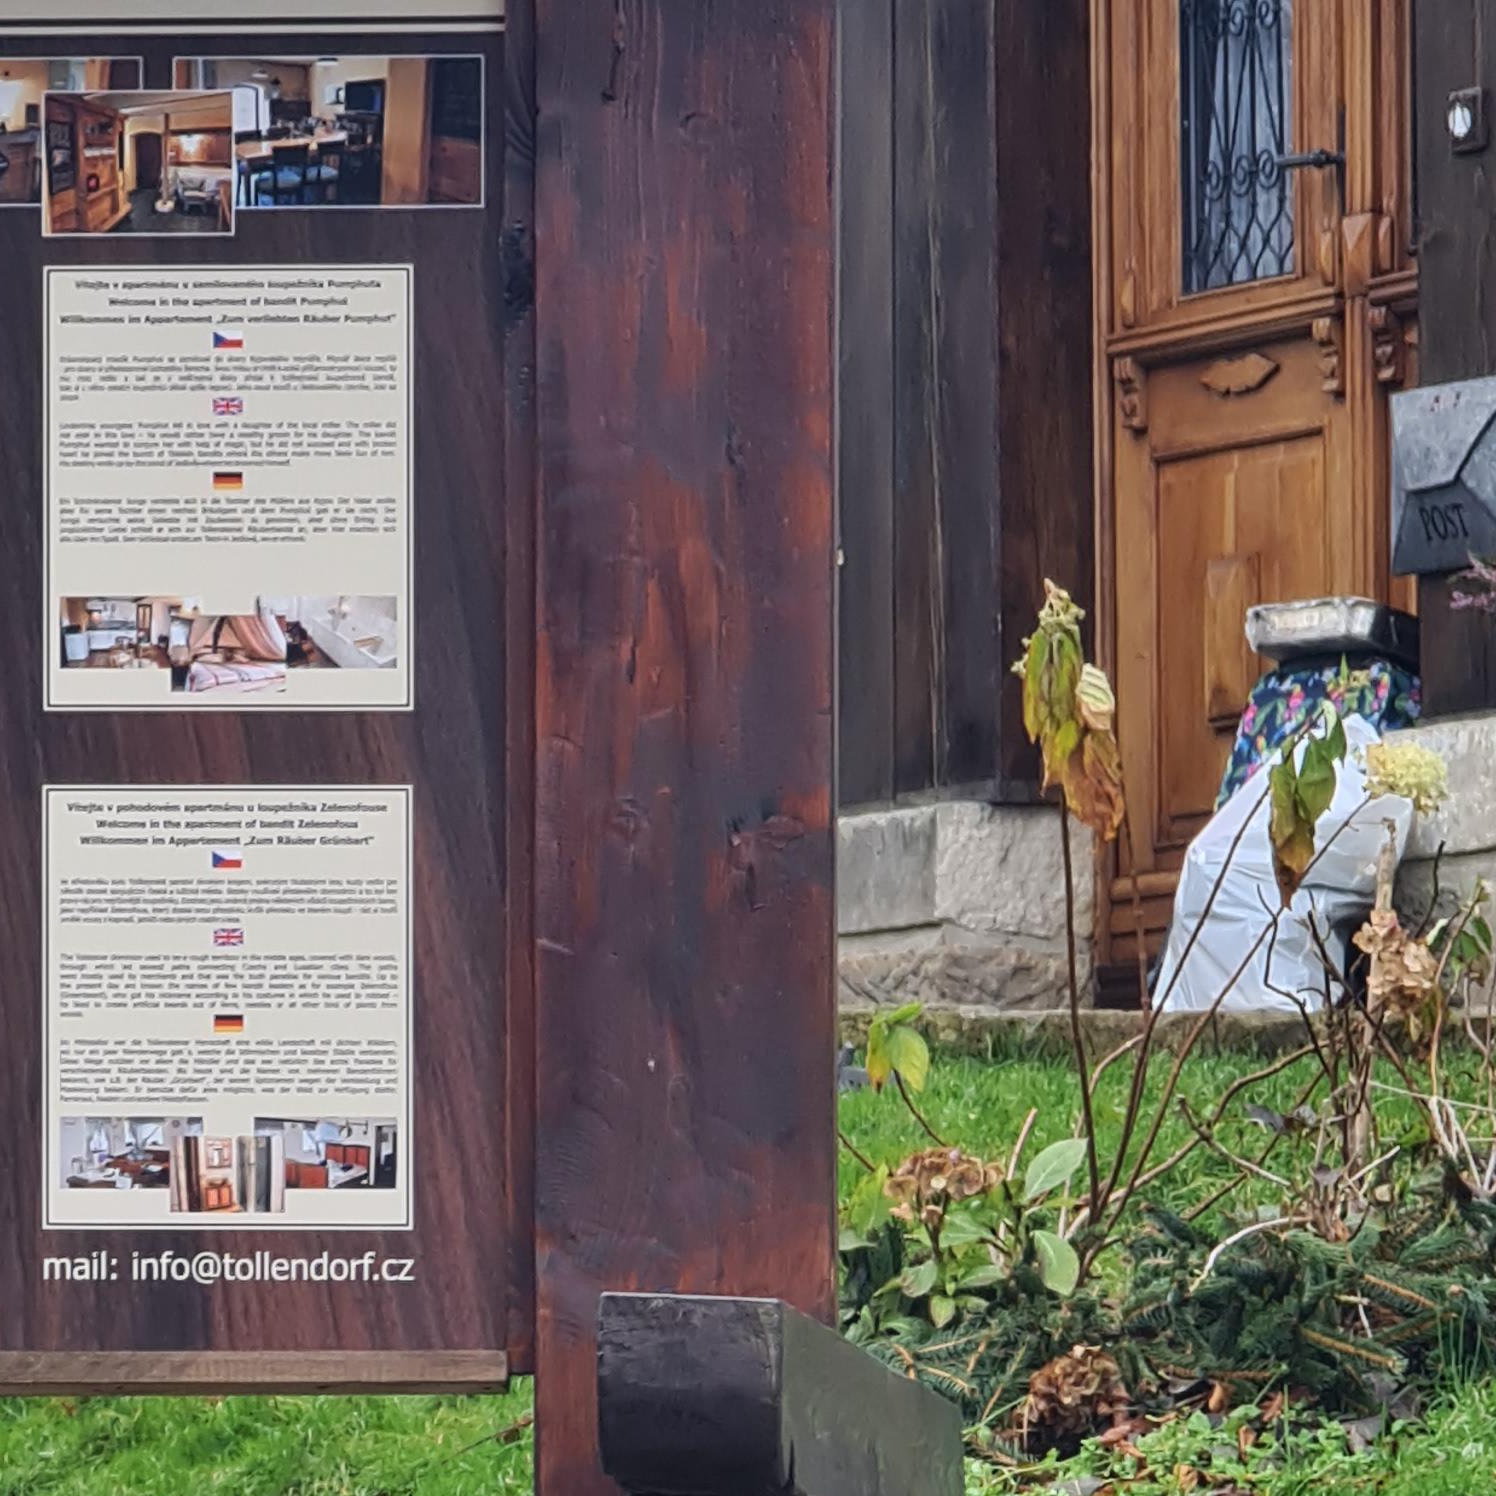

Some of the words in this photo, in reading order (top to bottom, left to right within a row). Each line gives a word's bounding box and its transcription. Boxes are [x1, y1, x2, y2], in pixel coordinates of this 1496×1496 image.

[1419, 503, 1468, 542] POST
[42, 1251, 118, 1281] mail:
[132, 1251, 416, 1284] info@tollendorf.cz
